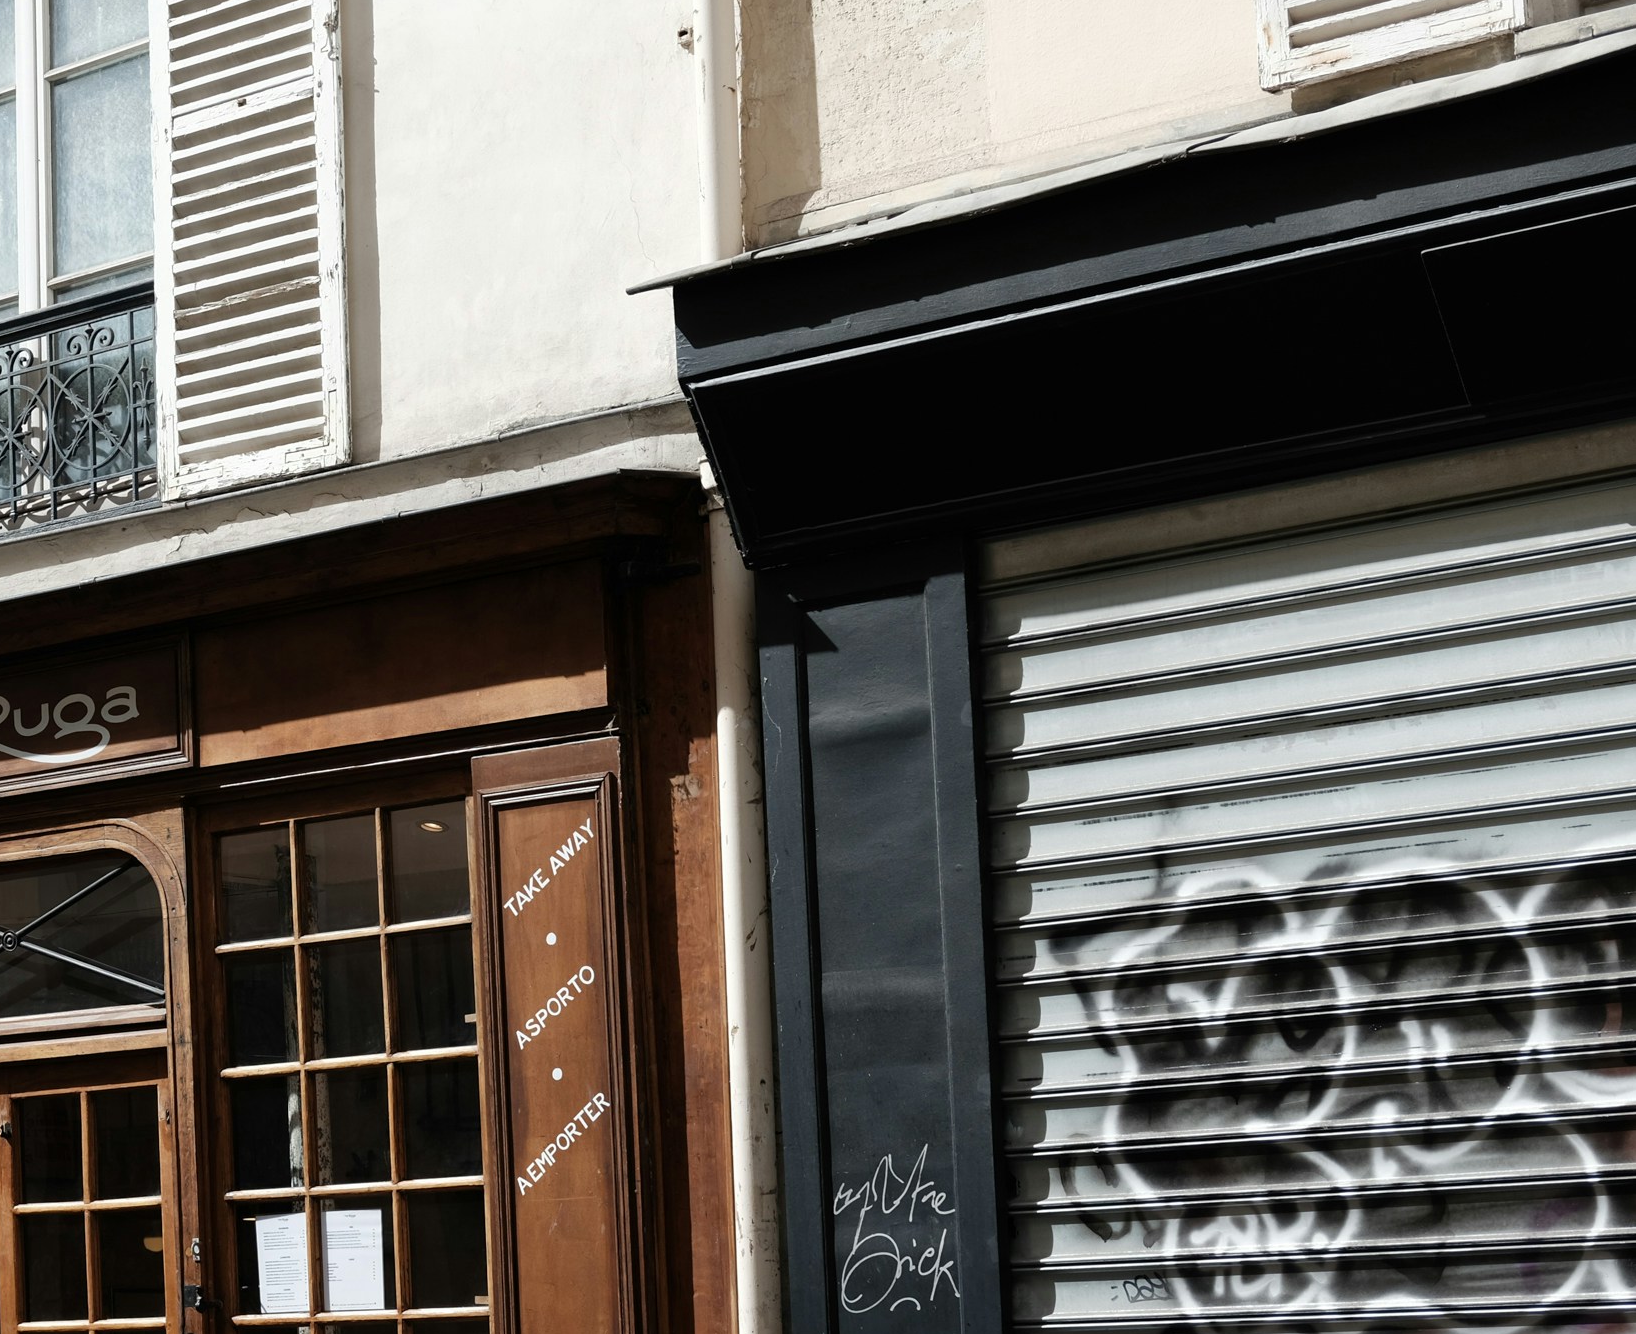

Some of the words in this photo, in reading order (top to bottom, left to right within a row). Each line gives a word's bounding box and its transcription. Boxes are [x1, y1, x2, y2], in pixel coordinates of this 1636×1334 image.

[503, 868, 550, 917] TAKE
[549, 817, 595, 876] AWAY
[515, 965, 595, 1050] ASPORTO
